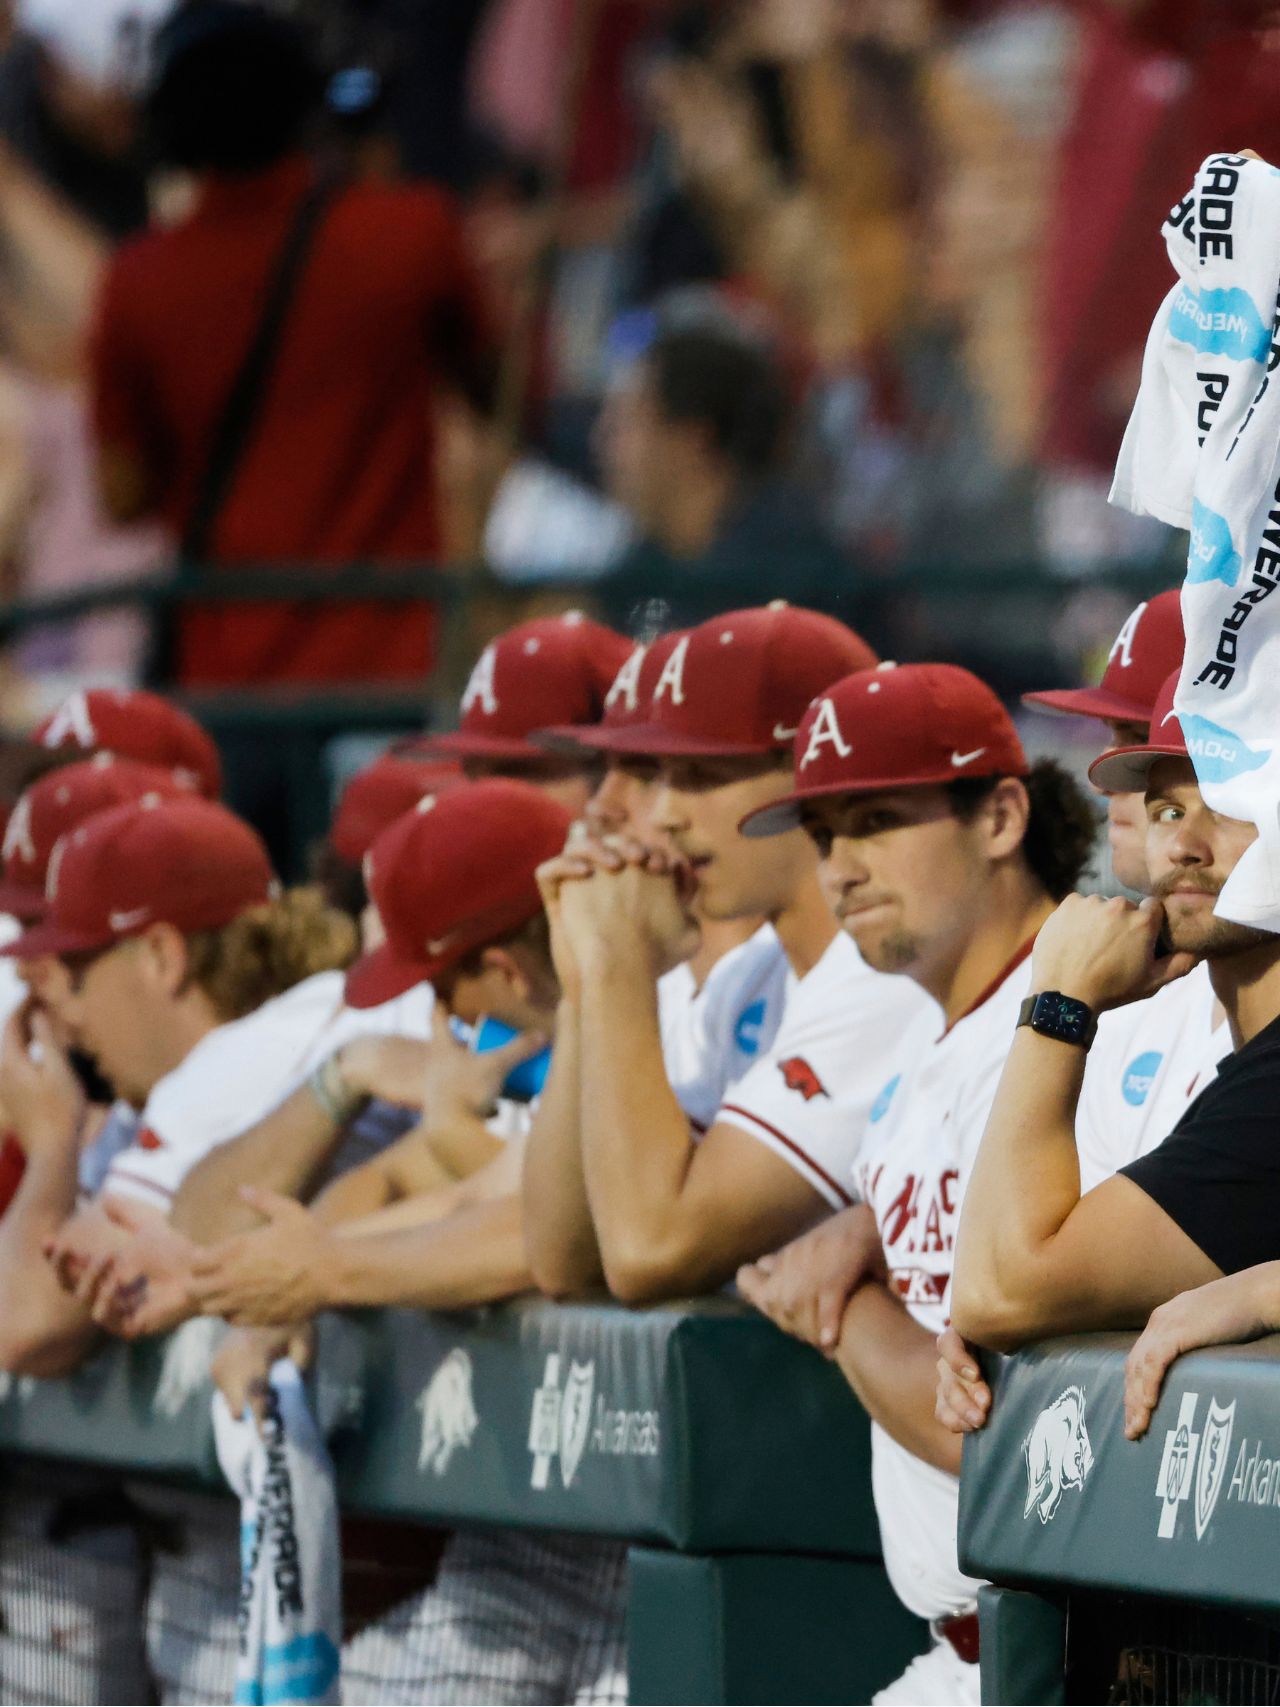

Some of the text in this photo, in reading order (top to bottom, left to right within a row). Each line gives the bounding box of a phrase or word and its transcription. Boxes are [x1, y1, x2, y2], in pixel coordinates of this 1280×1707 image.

[1108, 601, 1148, 668] A
[461, 643, 498, 714] A
[606, 643, 648, 711] A
[653, 636, 690, 705] A
[801, 697, 853, 771] A
